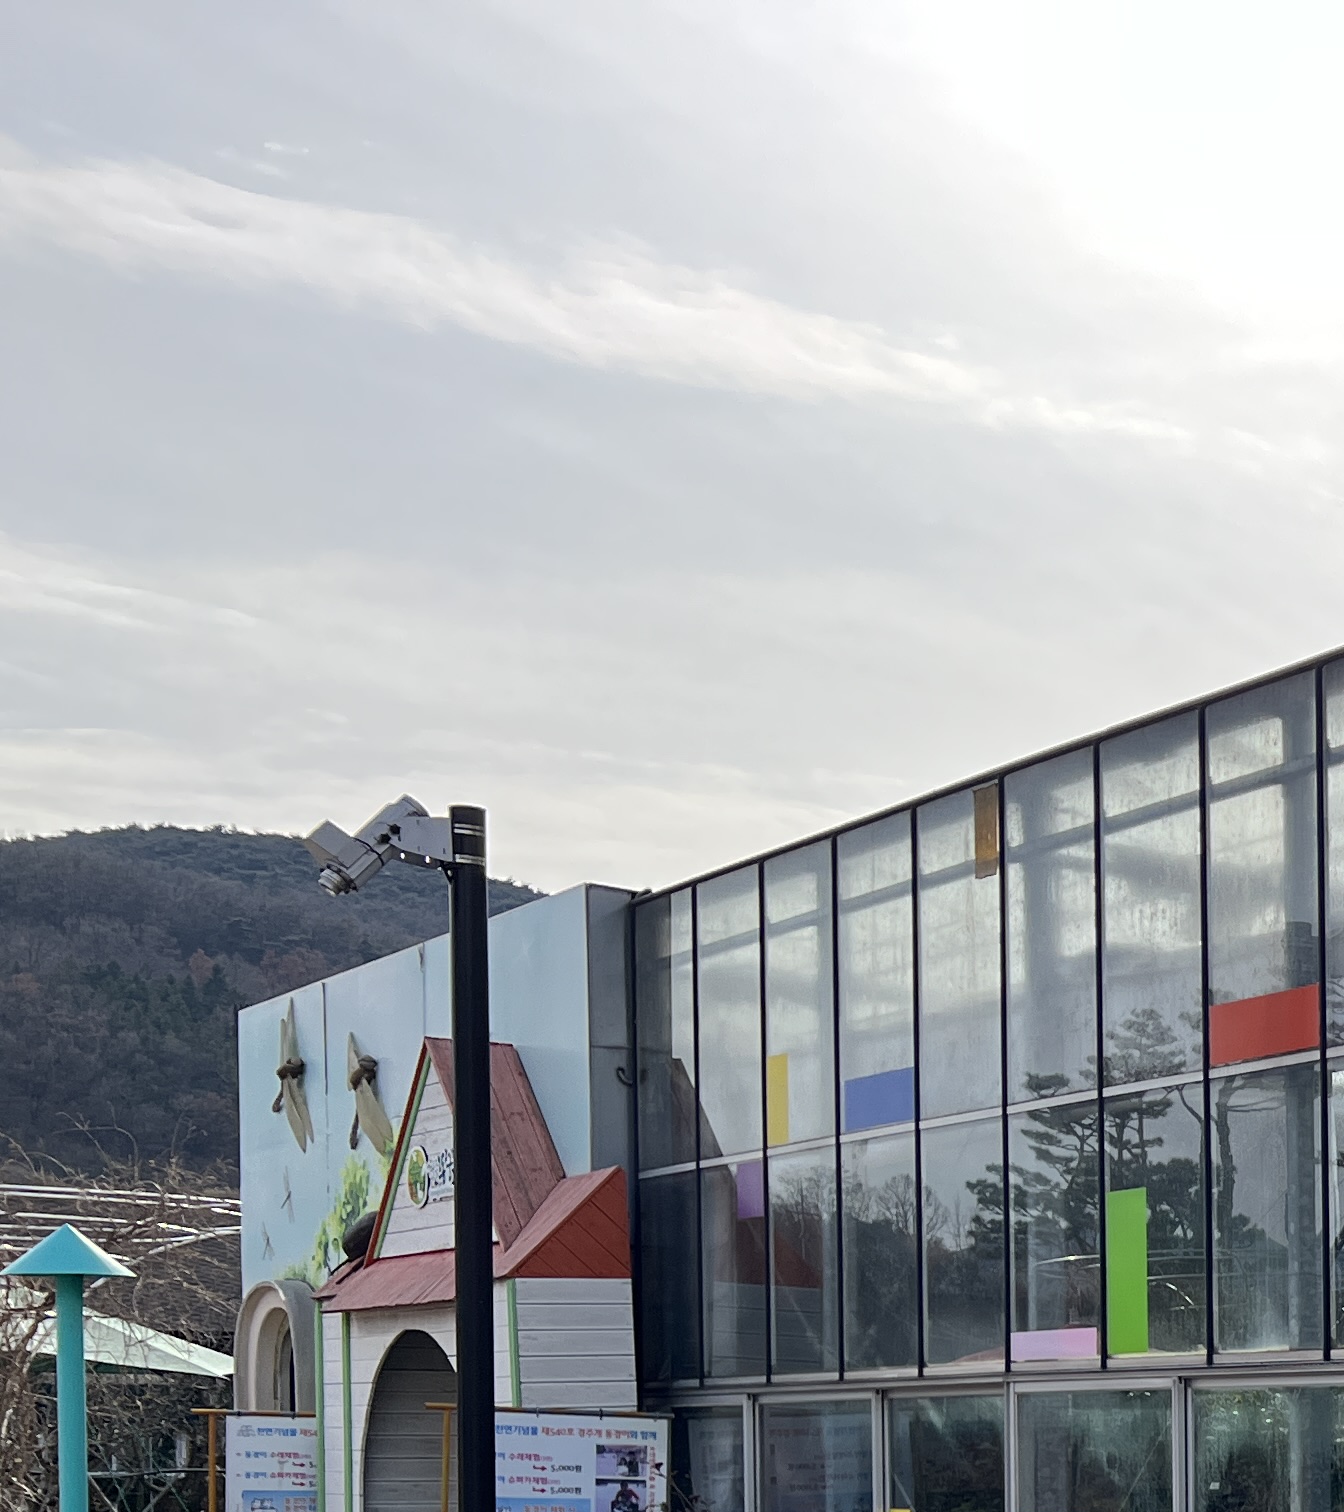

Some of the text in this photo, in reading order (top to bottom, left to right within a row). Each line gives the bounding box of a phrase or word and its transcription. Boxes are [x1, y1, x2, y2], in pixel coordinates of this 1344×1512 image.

[257, 1427, 297, 1437] 천연기념물
[496, 1424, 657, 1441] 천연기념물 제540호 경주개 동경이와 함께
[550, 1464, 582, 1473] 5,000원
[550, 1487, 582, 1495] 5,000원
